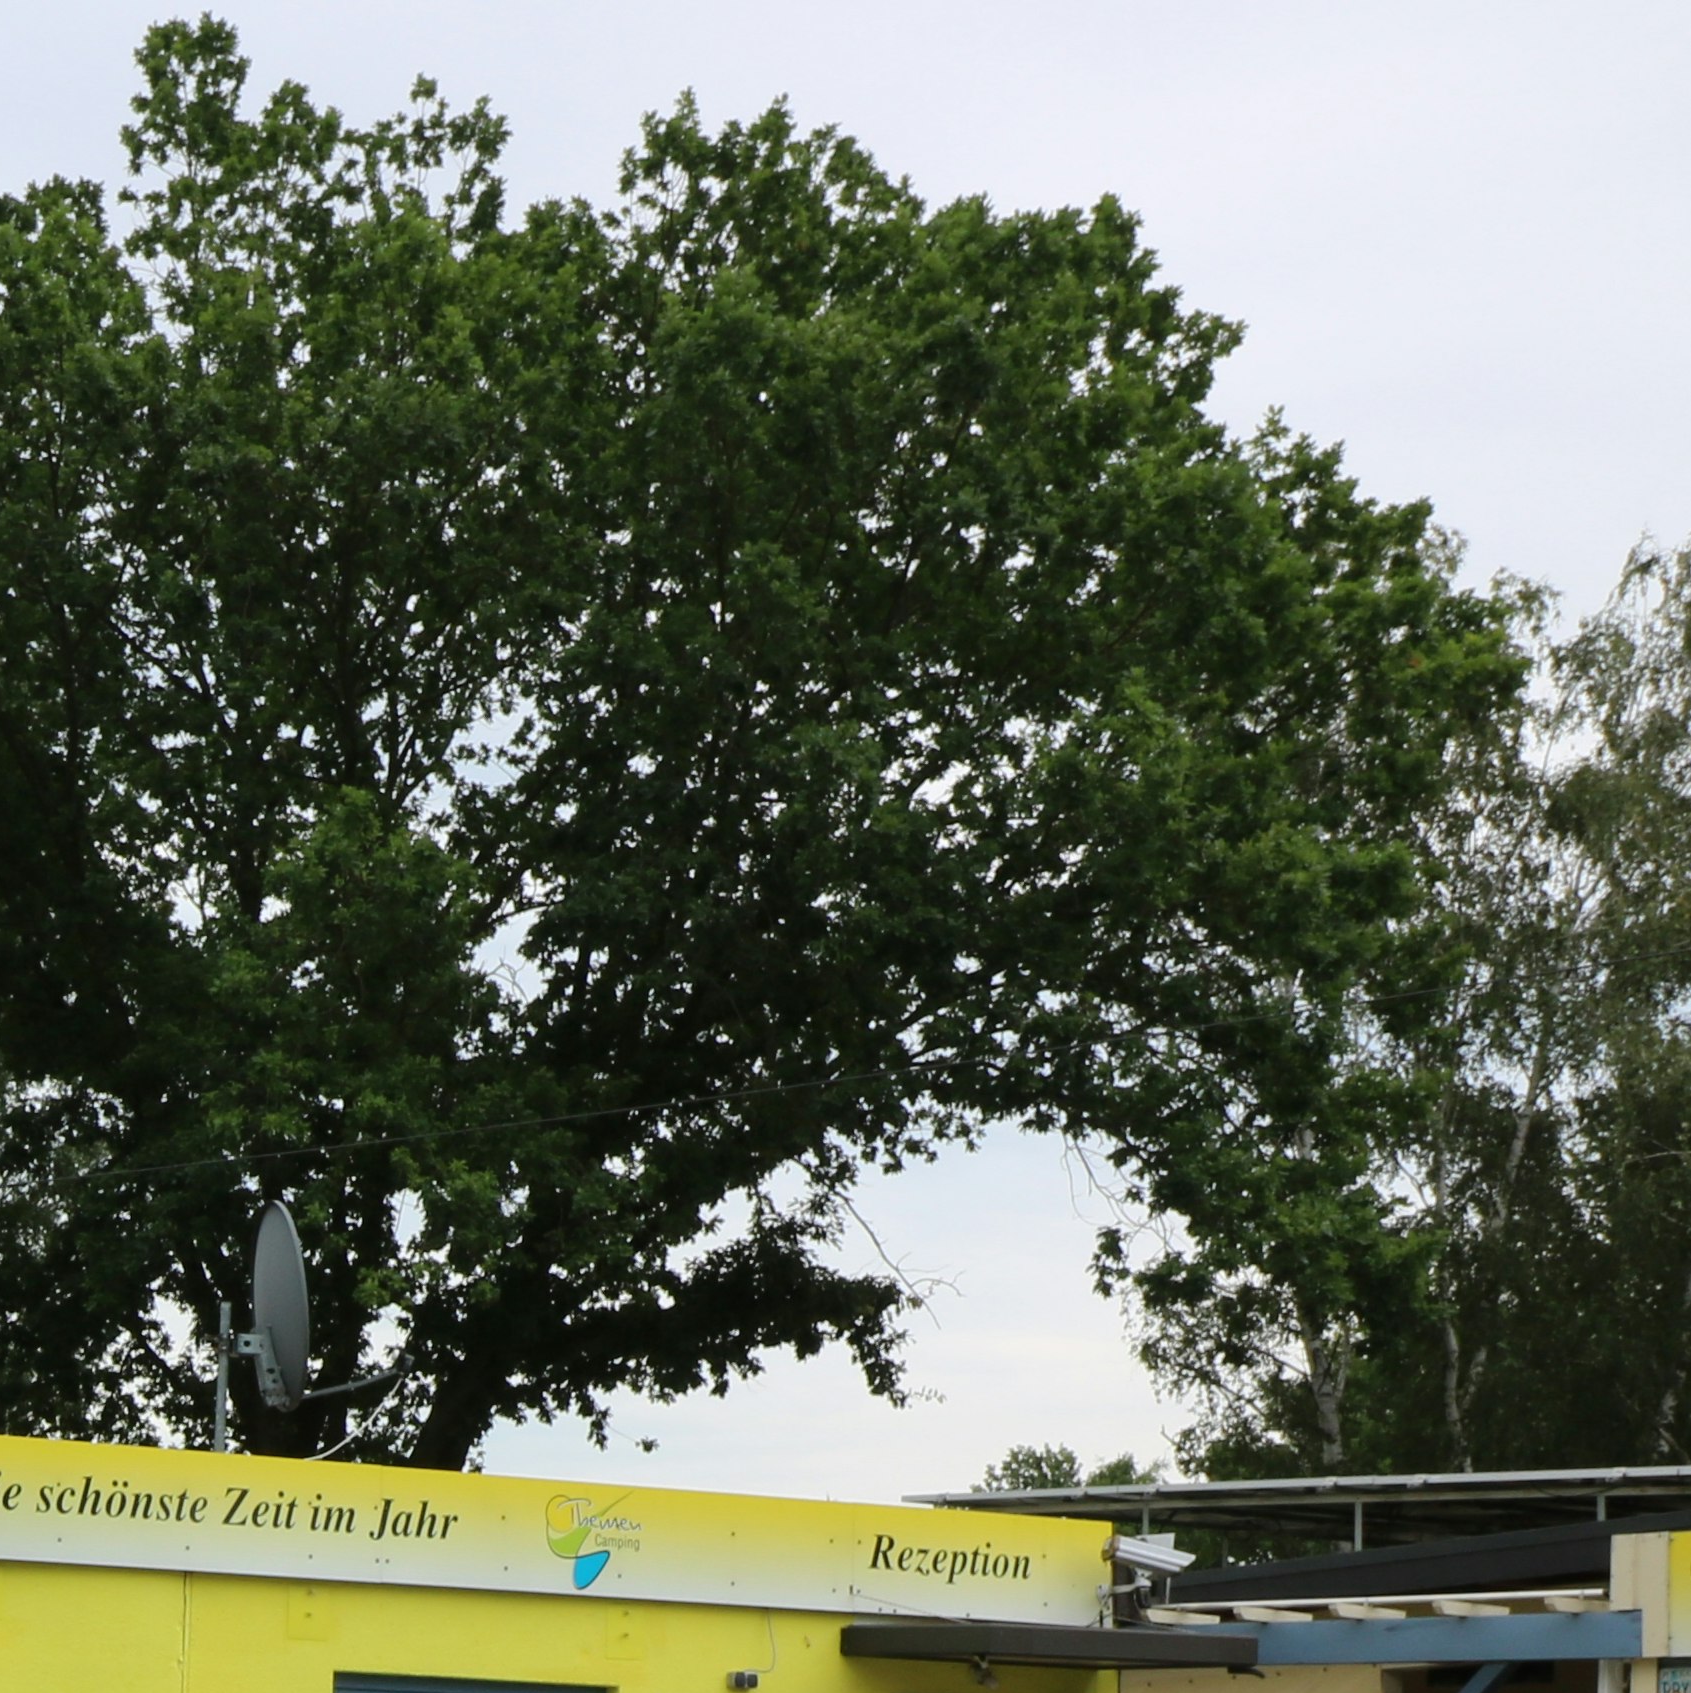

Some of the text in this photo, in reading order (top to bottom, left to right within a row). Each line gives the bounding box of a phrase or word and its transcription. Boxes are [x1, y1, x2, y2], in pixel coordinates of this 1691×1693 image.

[35, 1475, 208, 1524] schönste
[220, 1486, 300, 1532] Zeit
[306, 1493, 357, 1534] im
[368, 1498, 460, 1542] Jahr
[557, 1497, 641, 1531] Themen
[594, 1533, 641, 1552] Camping
[868, 1532, 1032, 1585] Rezeption
